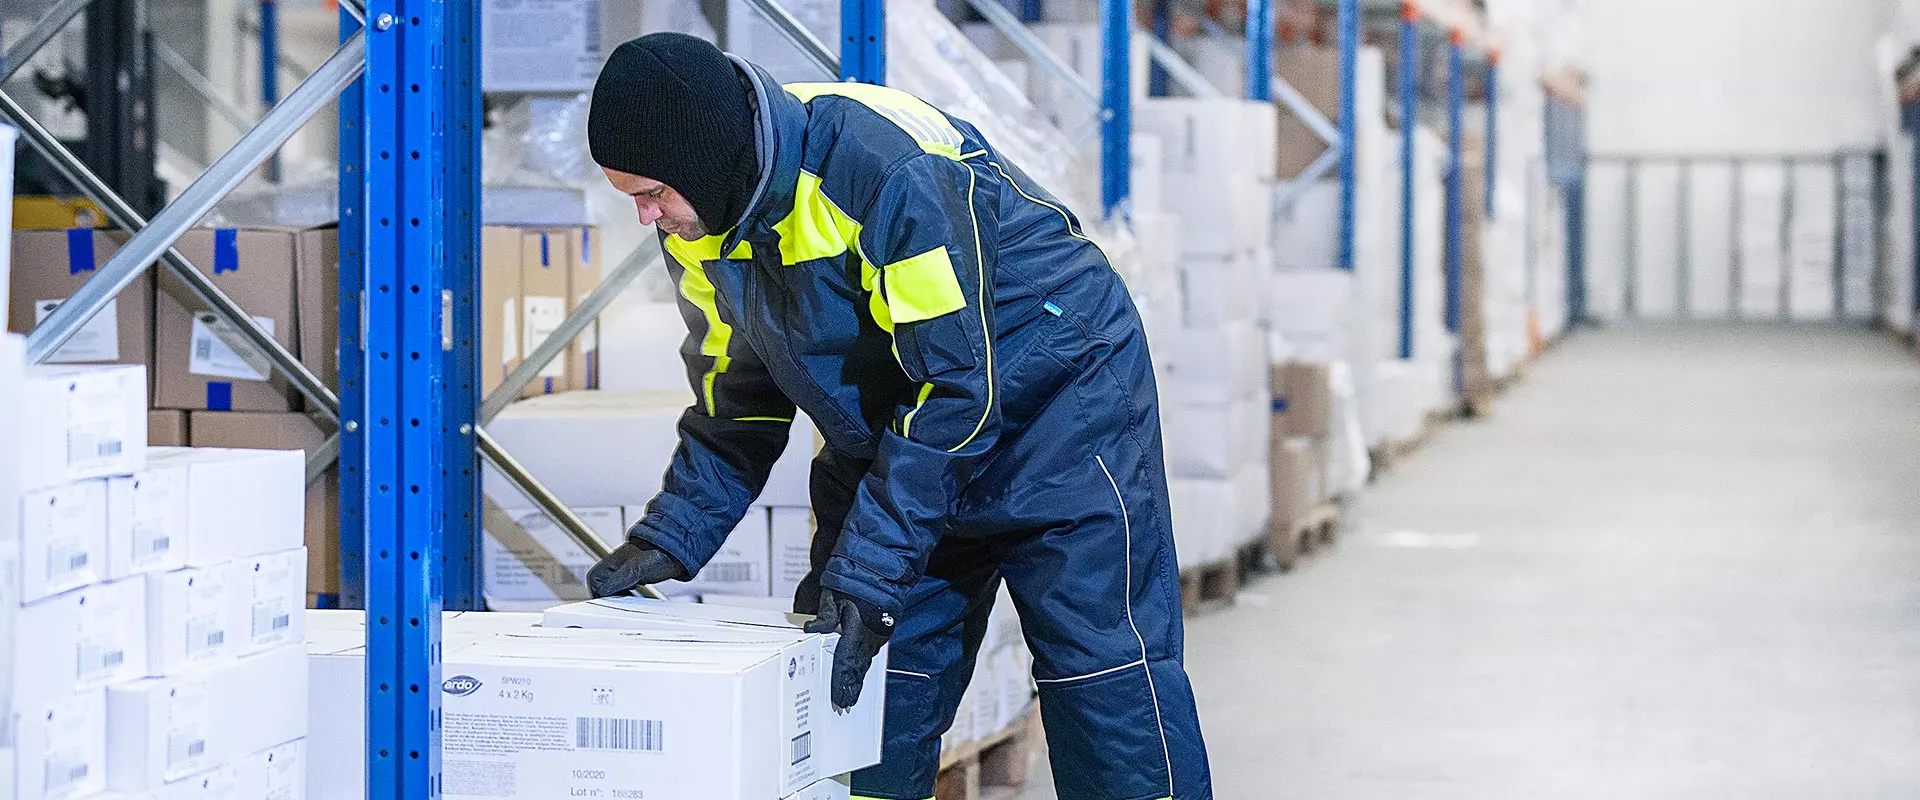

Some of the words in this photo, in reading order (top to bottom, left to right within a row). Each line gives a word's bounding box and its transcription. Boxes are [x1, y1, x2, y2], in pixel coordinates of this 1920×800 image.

[444, 680, 473, 690] ardo
[499, 690, 504, 698] 4
[506, 691, 512, 699] x
[514, 690, 519, 699] 2
[521, 689, 534, 702] Kg
[572, 770, 605, 779] 10/2020
[570, 787, 587, 796] Lot
